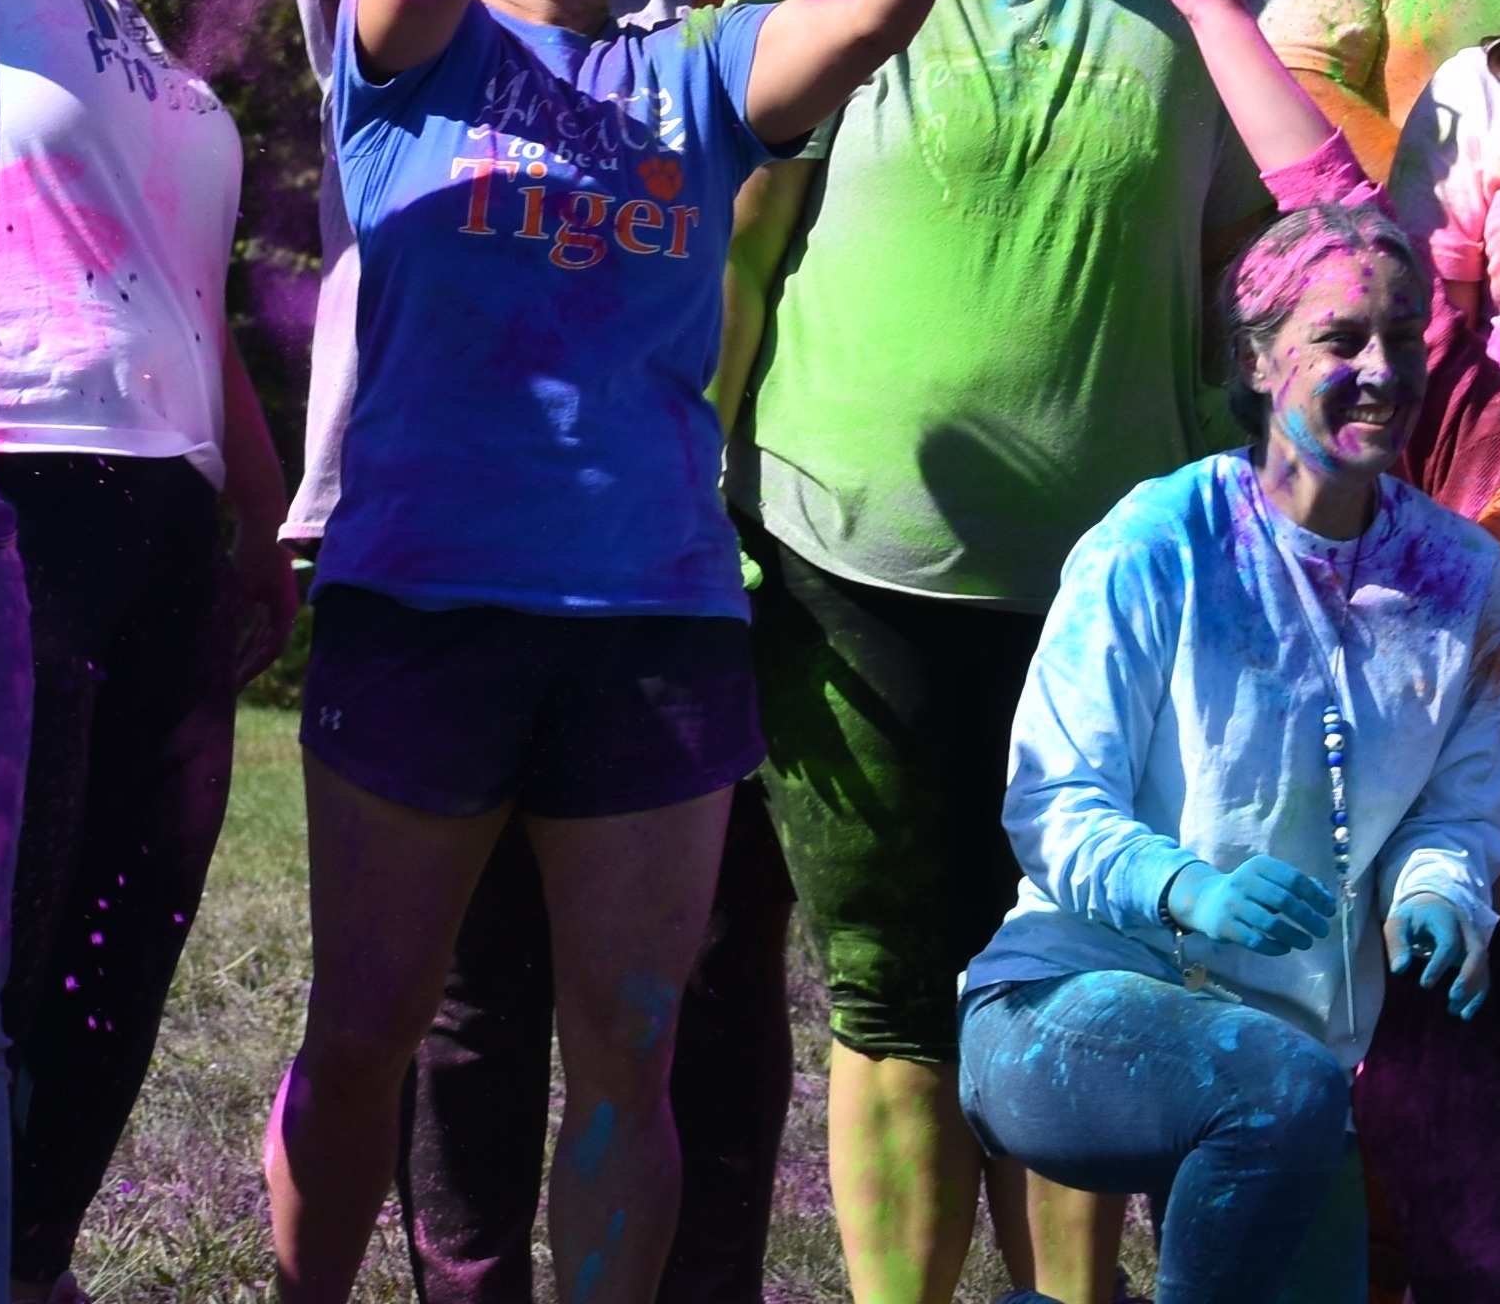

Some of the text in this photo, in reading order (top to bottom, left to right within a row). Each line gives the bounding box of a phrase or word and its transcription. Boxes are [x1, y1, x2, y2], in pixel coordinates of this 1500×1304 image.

[506, 136, 546, 159] to
[553, 140, 592, 168] be
[450, 157, 700, 271] Tiger
